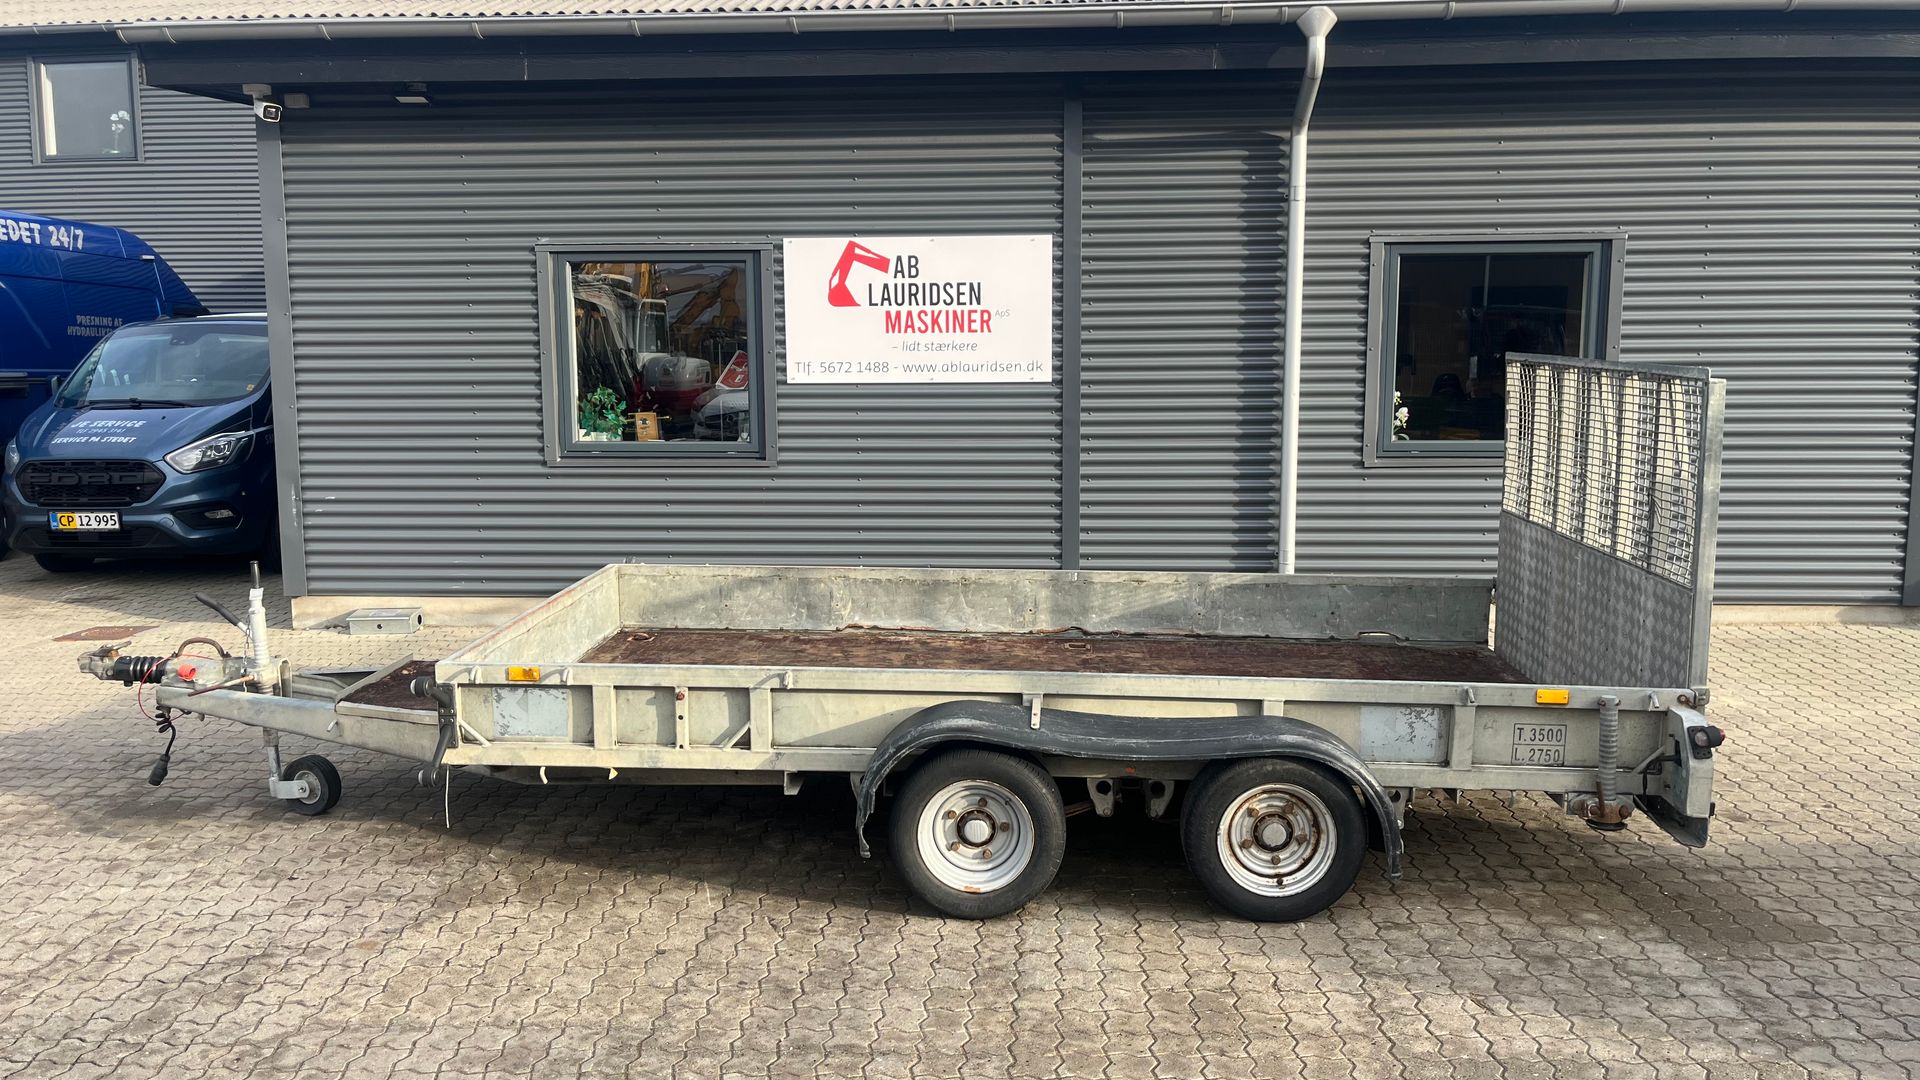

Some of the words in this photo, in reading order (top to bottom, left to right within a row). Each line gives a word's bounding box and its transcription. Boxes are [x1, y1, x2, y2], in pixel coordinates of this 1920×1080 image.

[48, 225, 84, 251] 24/7
[893, 254, 920, 279] AB
[868, 281, 982, 307] LAURIDSEN
[76, 315, 113, 327] PRESNING
[884, 308, 993, 334] MASKINER
[994, 308, 1011, 319] ApS
[901, 339, 922, 352] lidt
[923, 340, 978, 352] stærkere
[794, 360, 816, 377] Tlf.
[819, 361, 853, 374] 5672
[856, 361, 890, 374] 1488
[902, 360, 1044, 374] www.ablauridsen.dk
[89, 420, 147, 428] SERVICE
[51, 436, 89, 444] SERVICE
[101, 436, 137, 444] STEDET
[59, 514, 75, 527] CP
[78, 514, 93, 527] 12
[94, 514, 117, 527] 995
[1516, 727, 1564, 744] T.3500
[1514, 747, 1561, 763] L.2750
